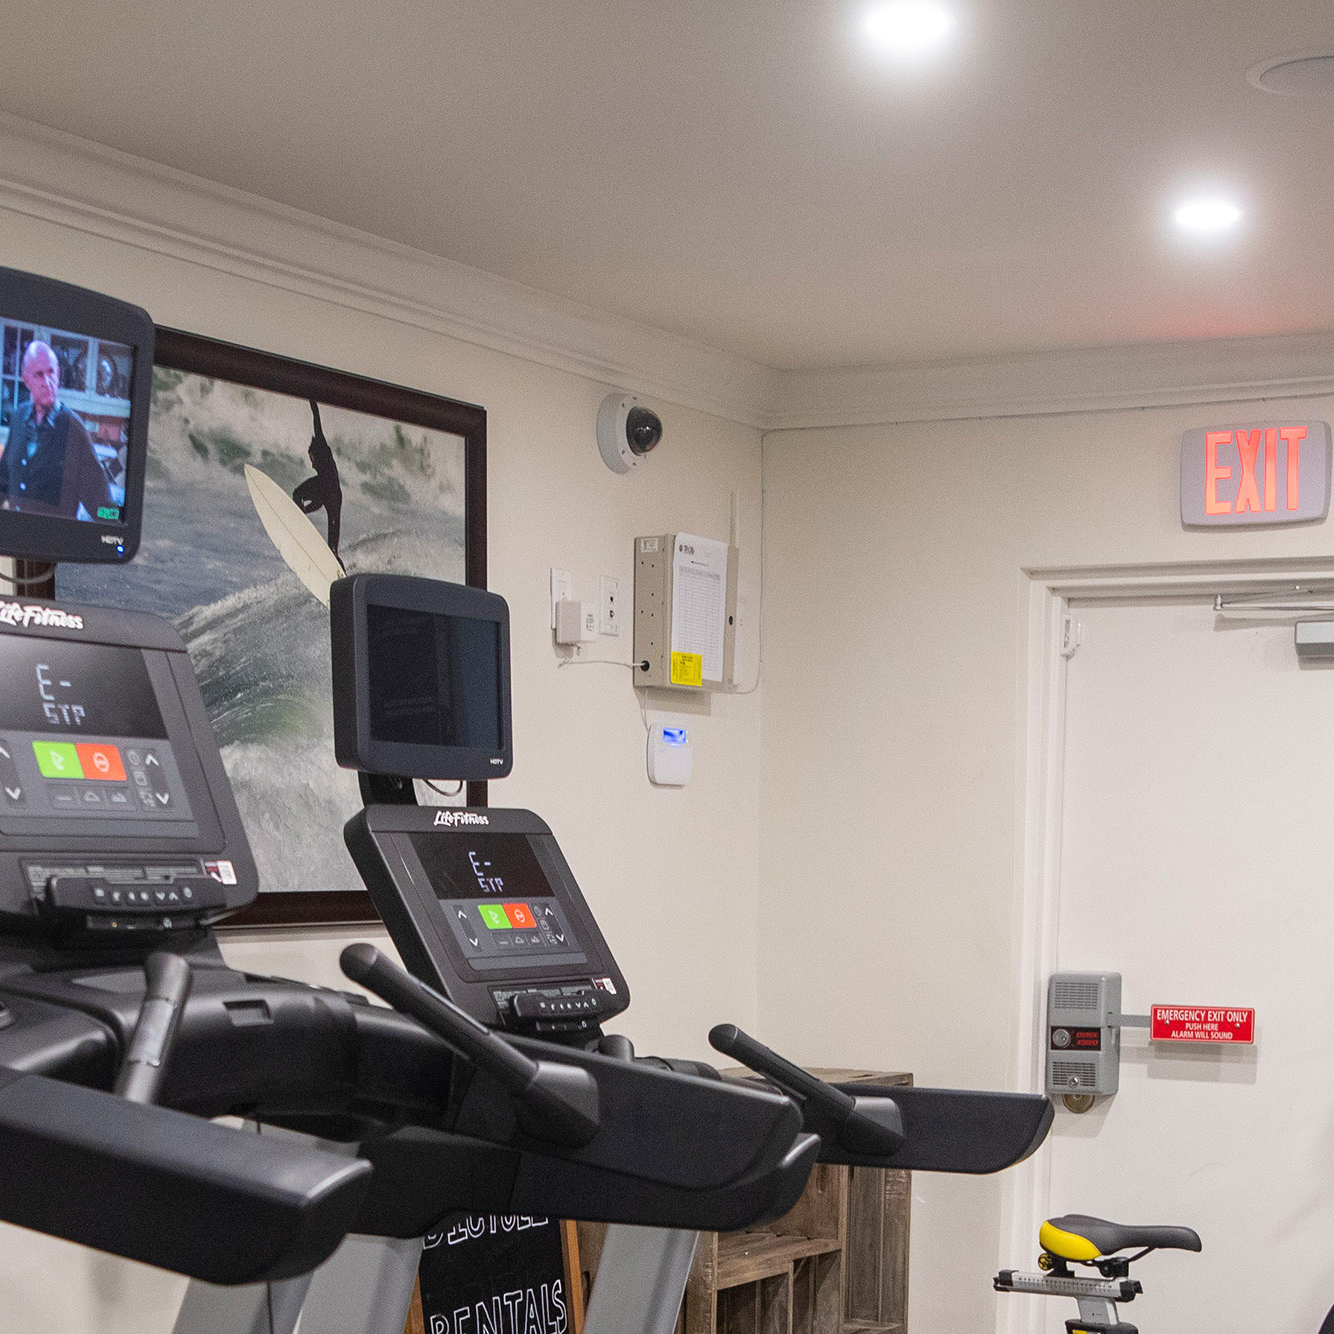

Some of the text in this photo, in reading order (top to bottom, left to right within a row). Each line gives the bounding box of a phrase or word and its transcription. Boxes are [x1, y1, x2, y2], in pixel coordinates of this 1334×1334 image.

[1205, 426, 1308, 516] EXIT
[1156, 1009, 1248, 1023] EMERGENCY EXIT ONLY
[1185, 1023, 1219, 1031] PUSH HERE
[1171, 1030, 1233, 1040] ALARM WILL SOUND
